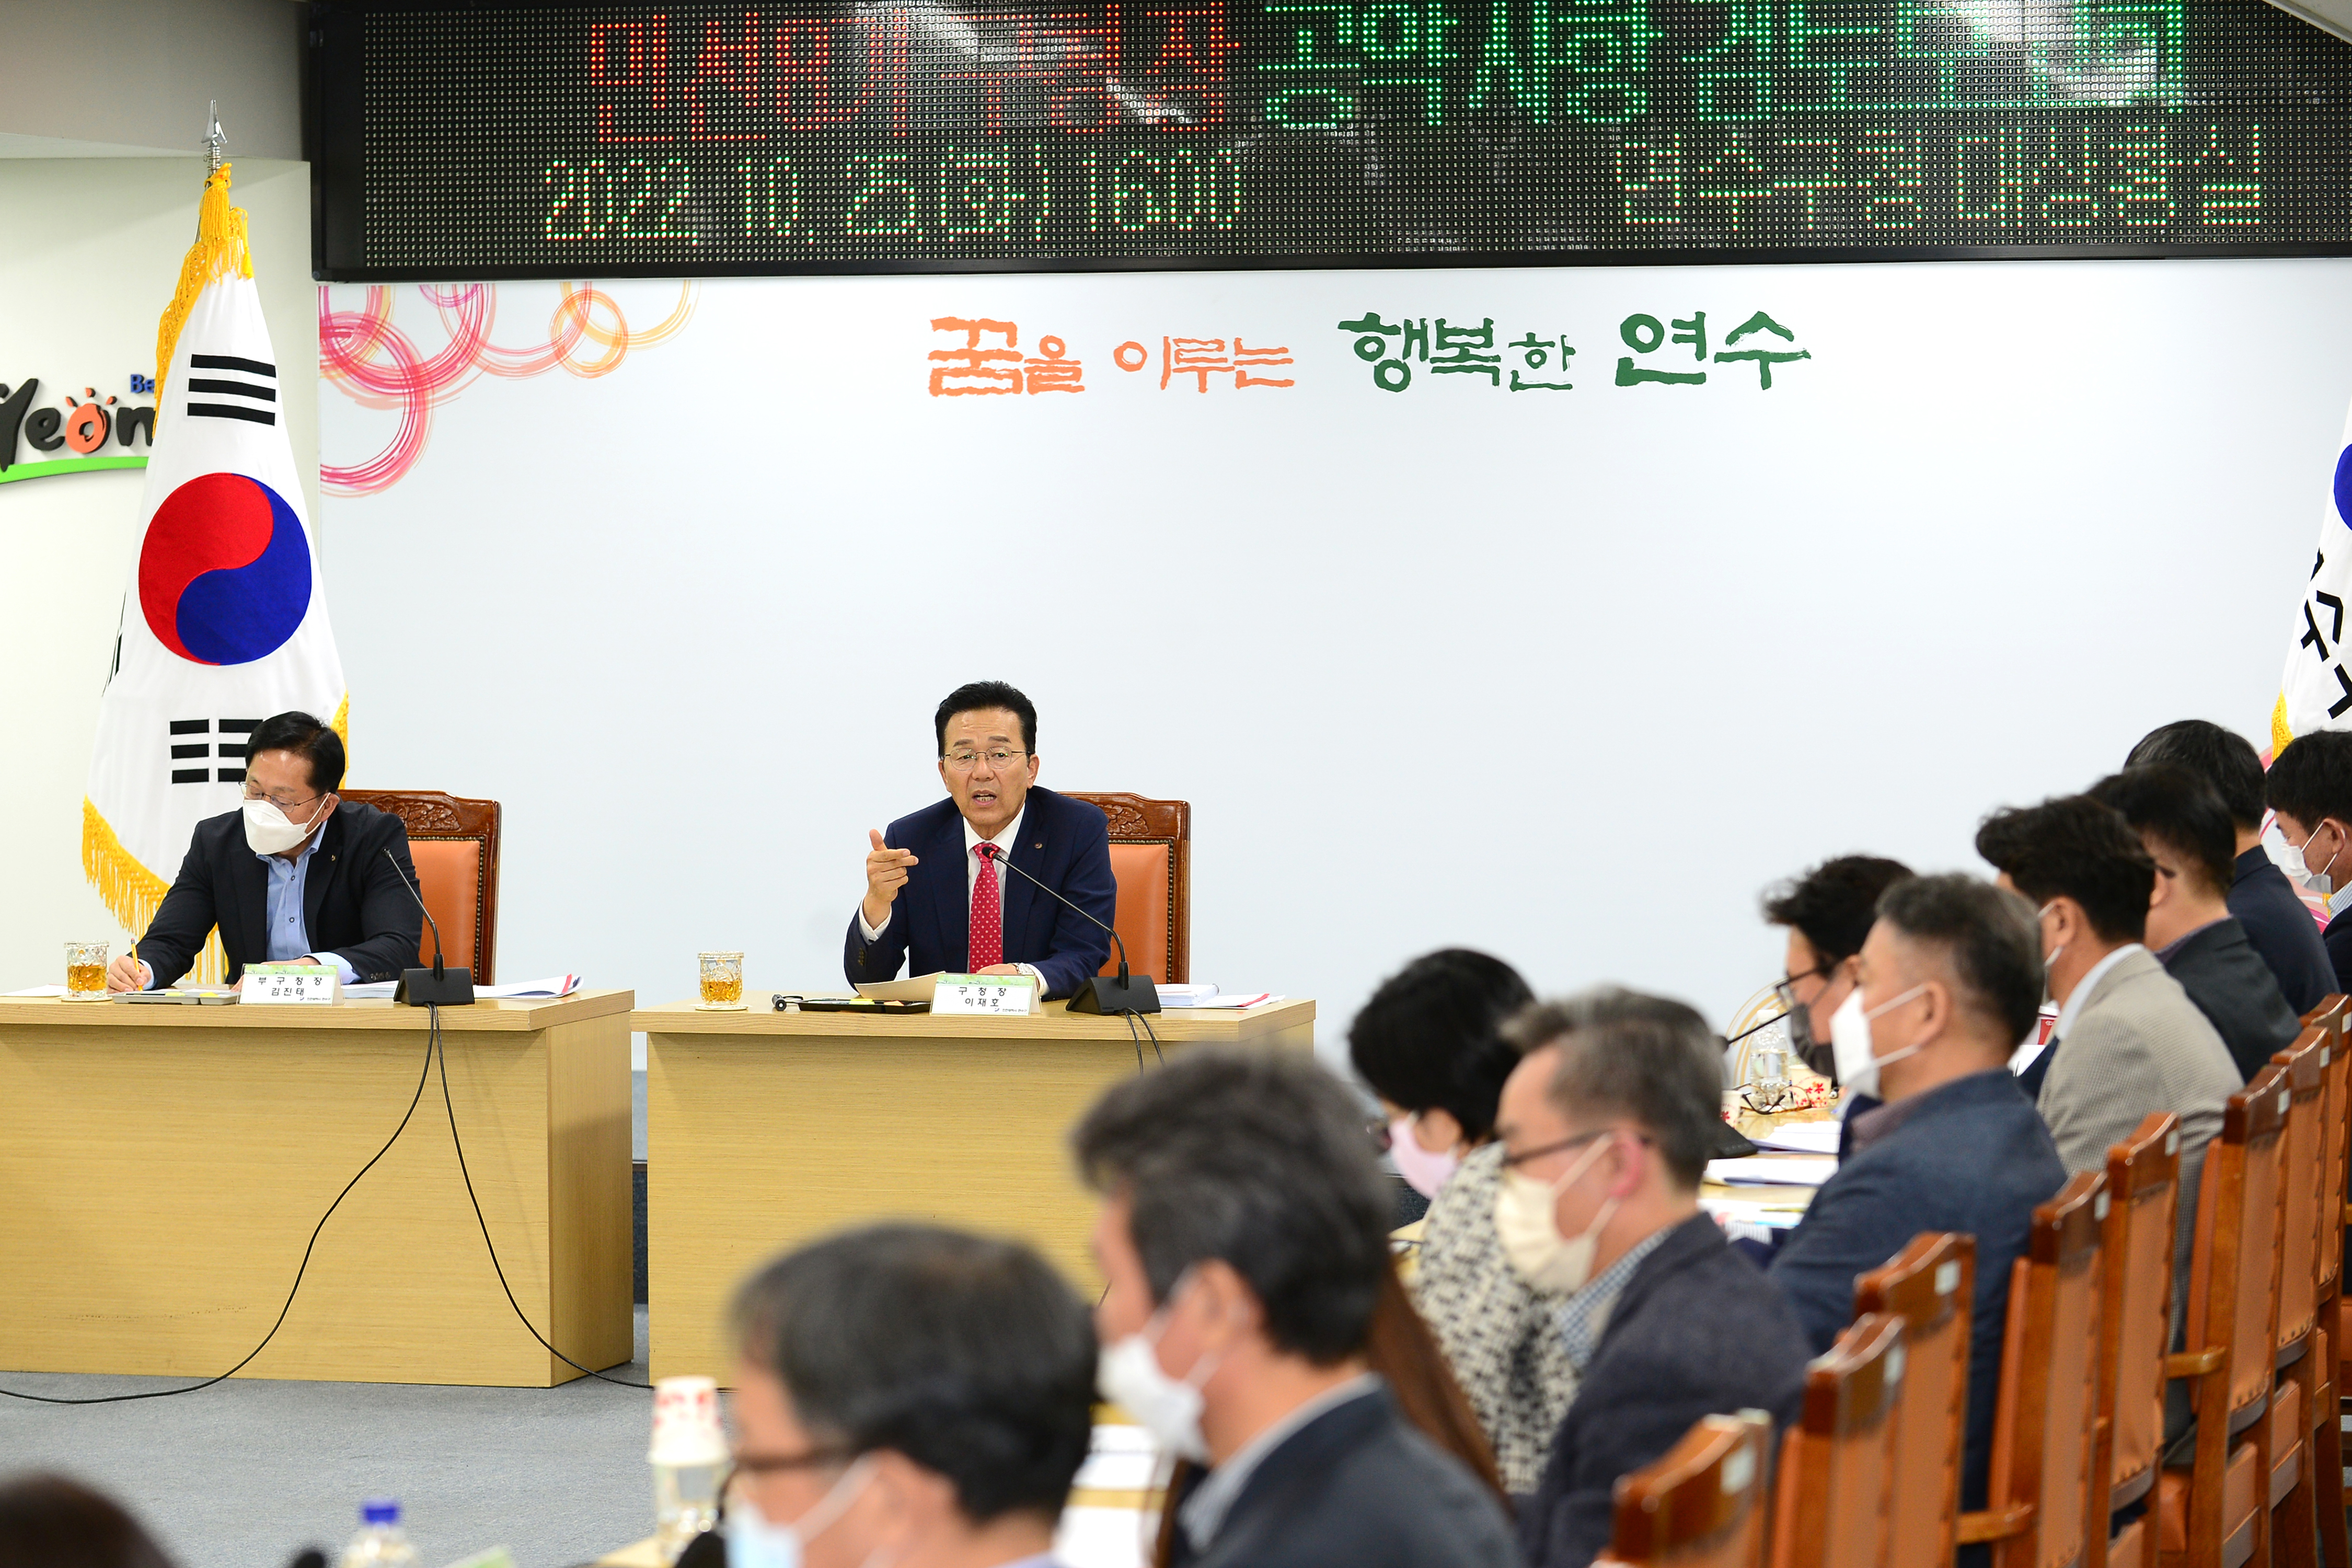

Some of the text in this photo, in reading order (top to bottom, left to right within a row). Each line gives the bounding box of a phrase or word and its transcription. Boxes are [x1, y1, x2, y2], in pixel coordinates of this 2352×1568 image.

[939, 1, 1242, 137] 구청장
[1255, 0, 1665, 130] 공약사항
[1081, 148, 1242, 234] 16:00
[1615, 123, 2261, 233] 연수구청 대상황실
[928, 311, 1811, 398] 꿈을 이루는 행복한 연수
[965, 998, 999, 1007] 이재호
